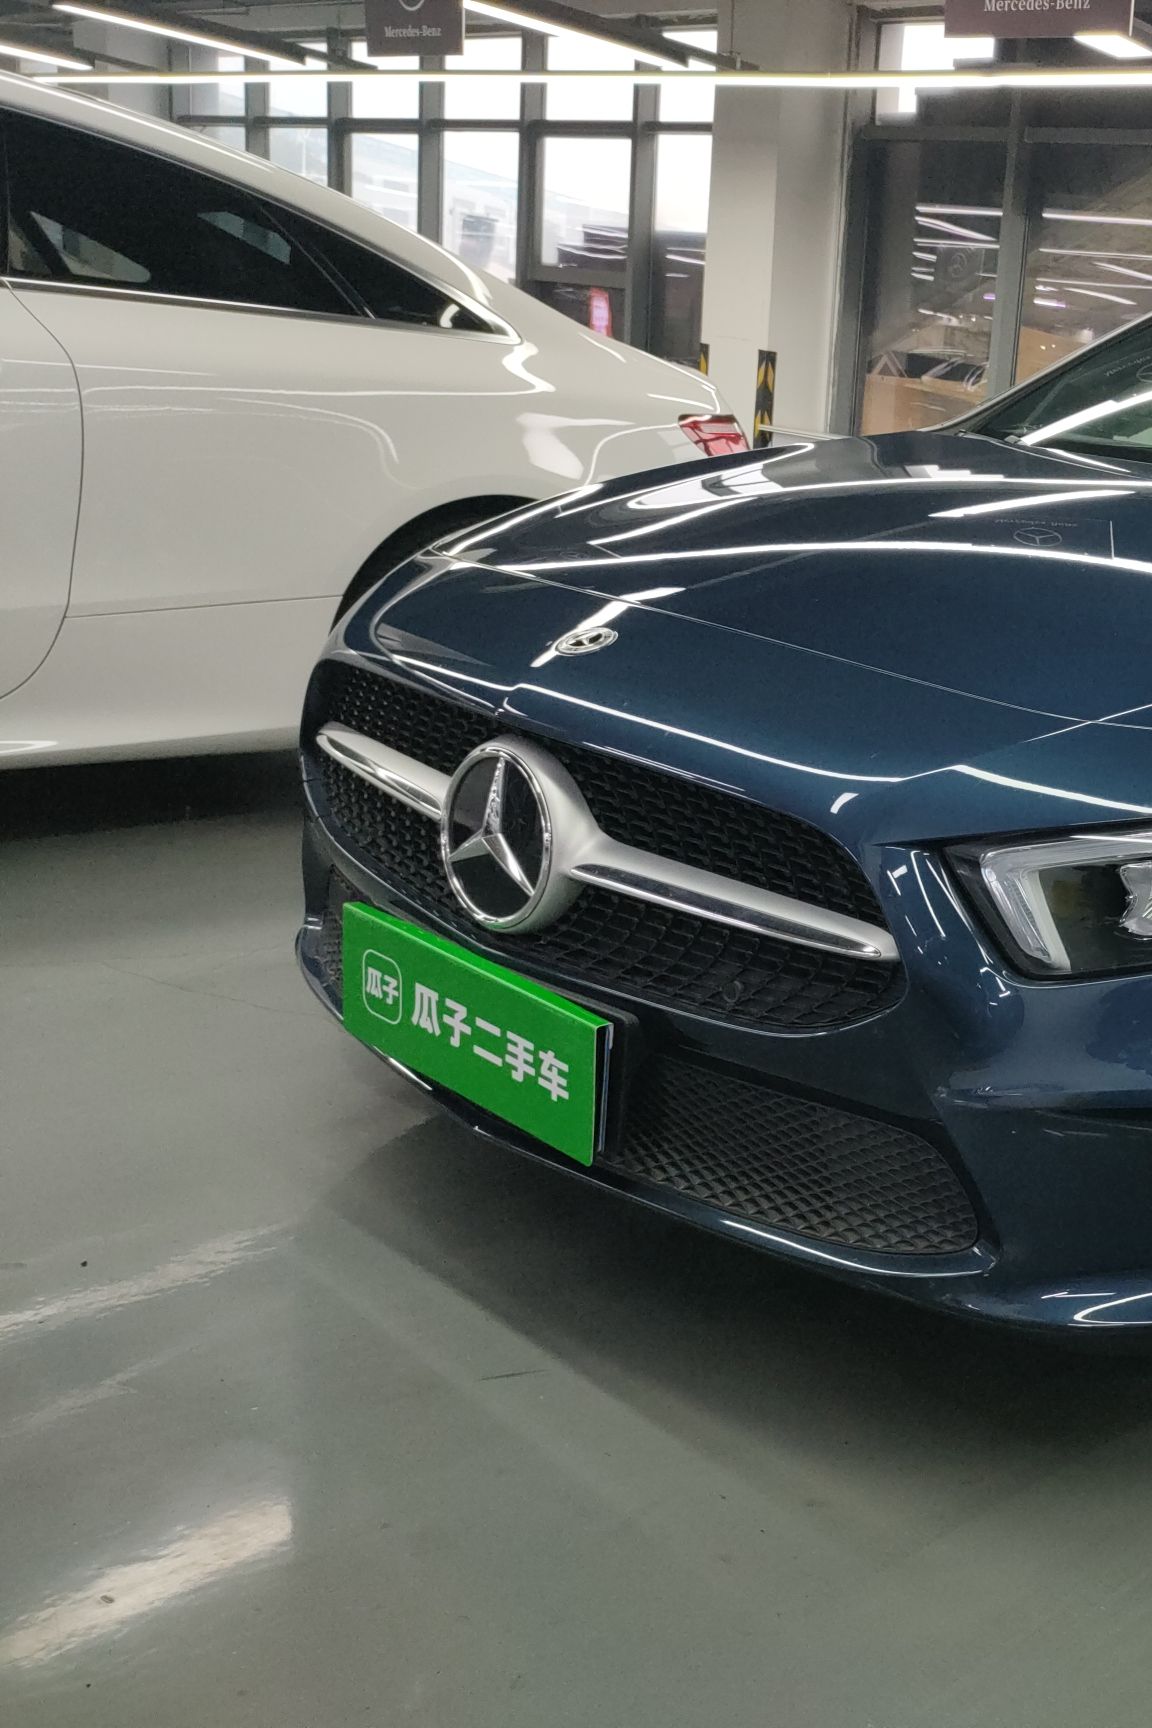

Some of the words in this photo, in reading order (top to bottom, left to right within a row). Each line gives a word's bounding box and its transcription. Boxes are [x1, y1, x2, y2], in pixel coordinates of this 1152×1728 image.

[984, 0, 1091, 12] Mercedes-Benz
[384, 25, 442, 38] Mercedes-Benz
[366, 967, 399, 1005] 瓜子
[411, 983, 569, 1101] 瓜子二手车
